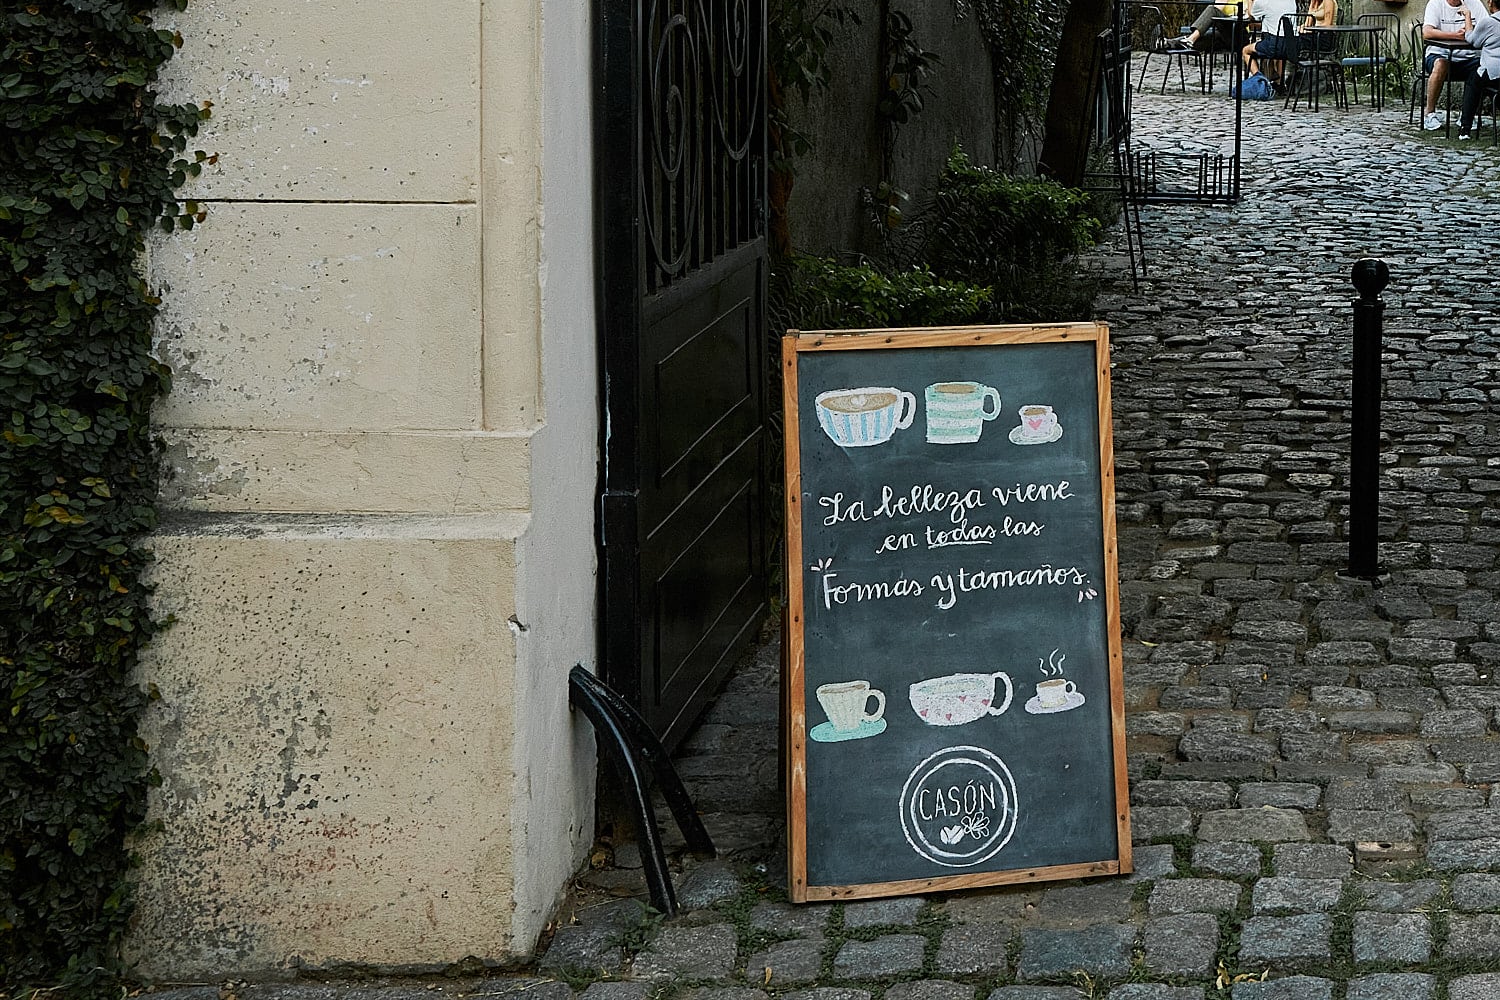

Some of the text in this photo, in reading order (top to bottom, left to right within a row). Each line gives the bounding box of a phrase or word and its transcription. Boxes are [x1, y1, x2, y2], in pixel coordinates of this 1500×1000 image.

[819, 479, 1075, 526] La belleza viene
[875, 516, 1045, 554] en todas las
[821, 572, 926, 610] Formas
[930, 573, 957, 610] y
[918, 779, 997, 821] CASÓN
